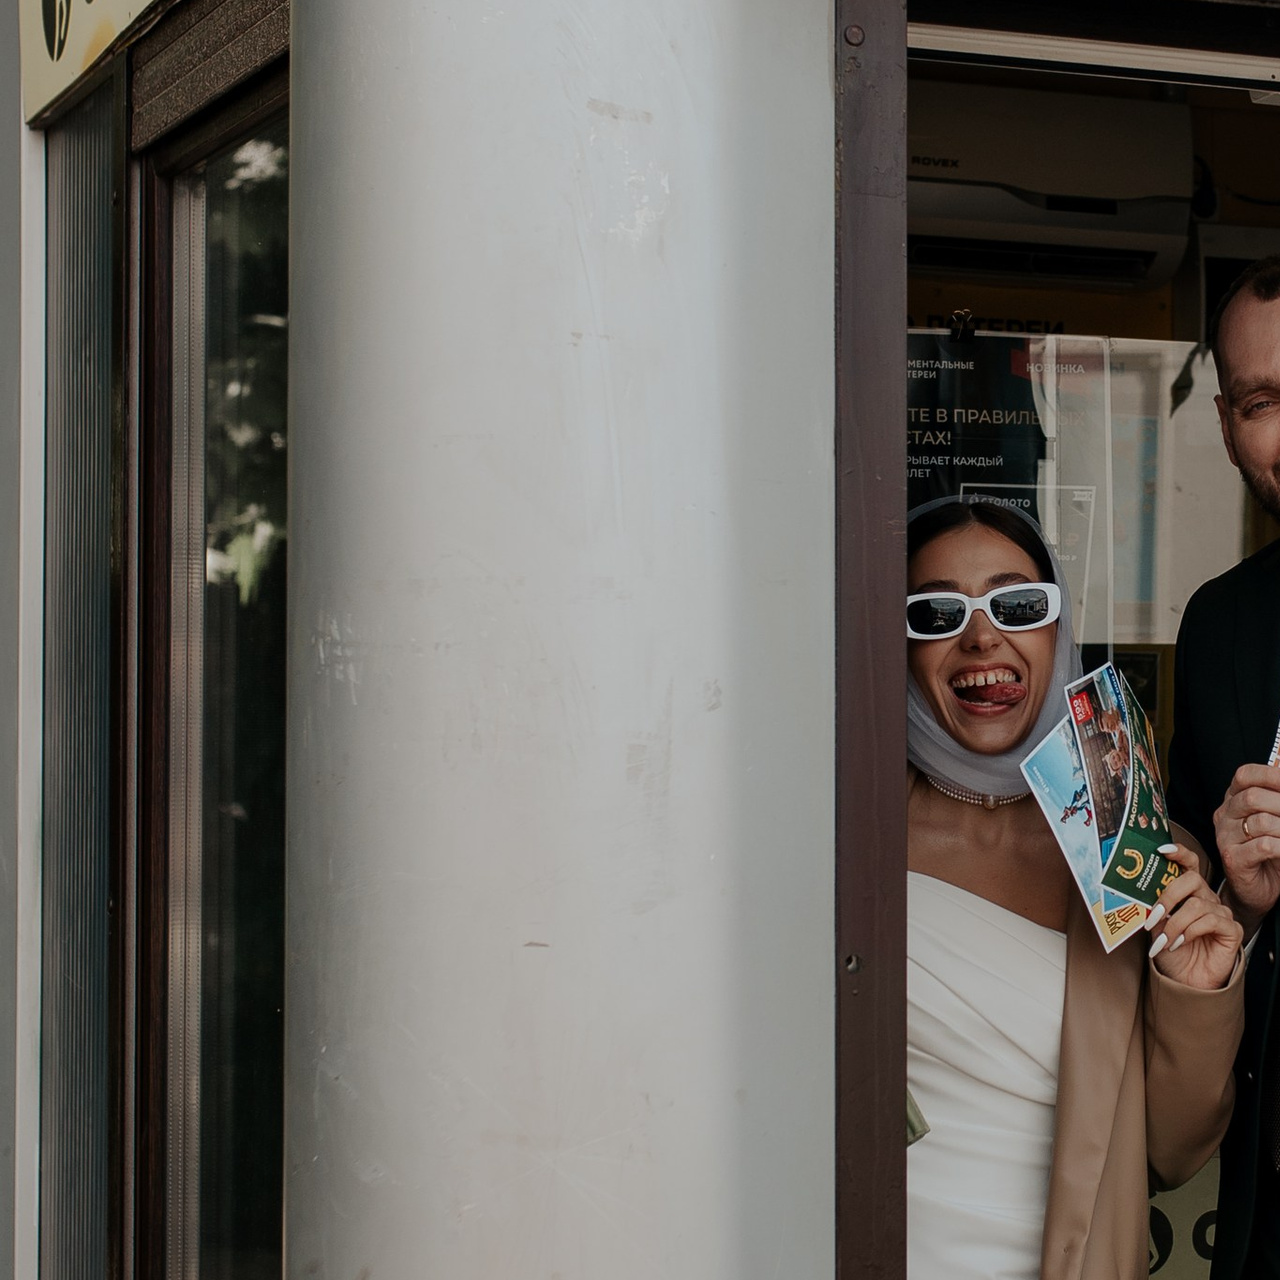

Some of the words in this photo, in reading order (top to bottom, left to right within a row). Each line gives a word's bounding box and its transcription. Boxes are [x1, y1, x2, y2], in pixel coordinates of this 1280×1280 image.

[911, 155, 960, 169] ROVEX
[907, 359, 975, 370] МЕНТАЛЬНЫЕ
[936, 408, 948, 423] В
[953, 455, 1004, 468] КАЖДЫЙ
[907, 468, 931, 478] ЛЕТ
[1136, 853, 1155, 889] Золотая
[1141, 855, 1160, 892] подкова
